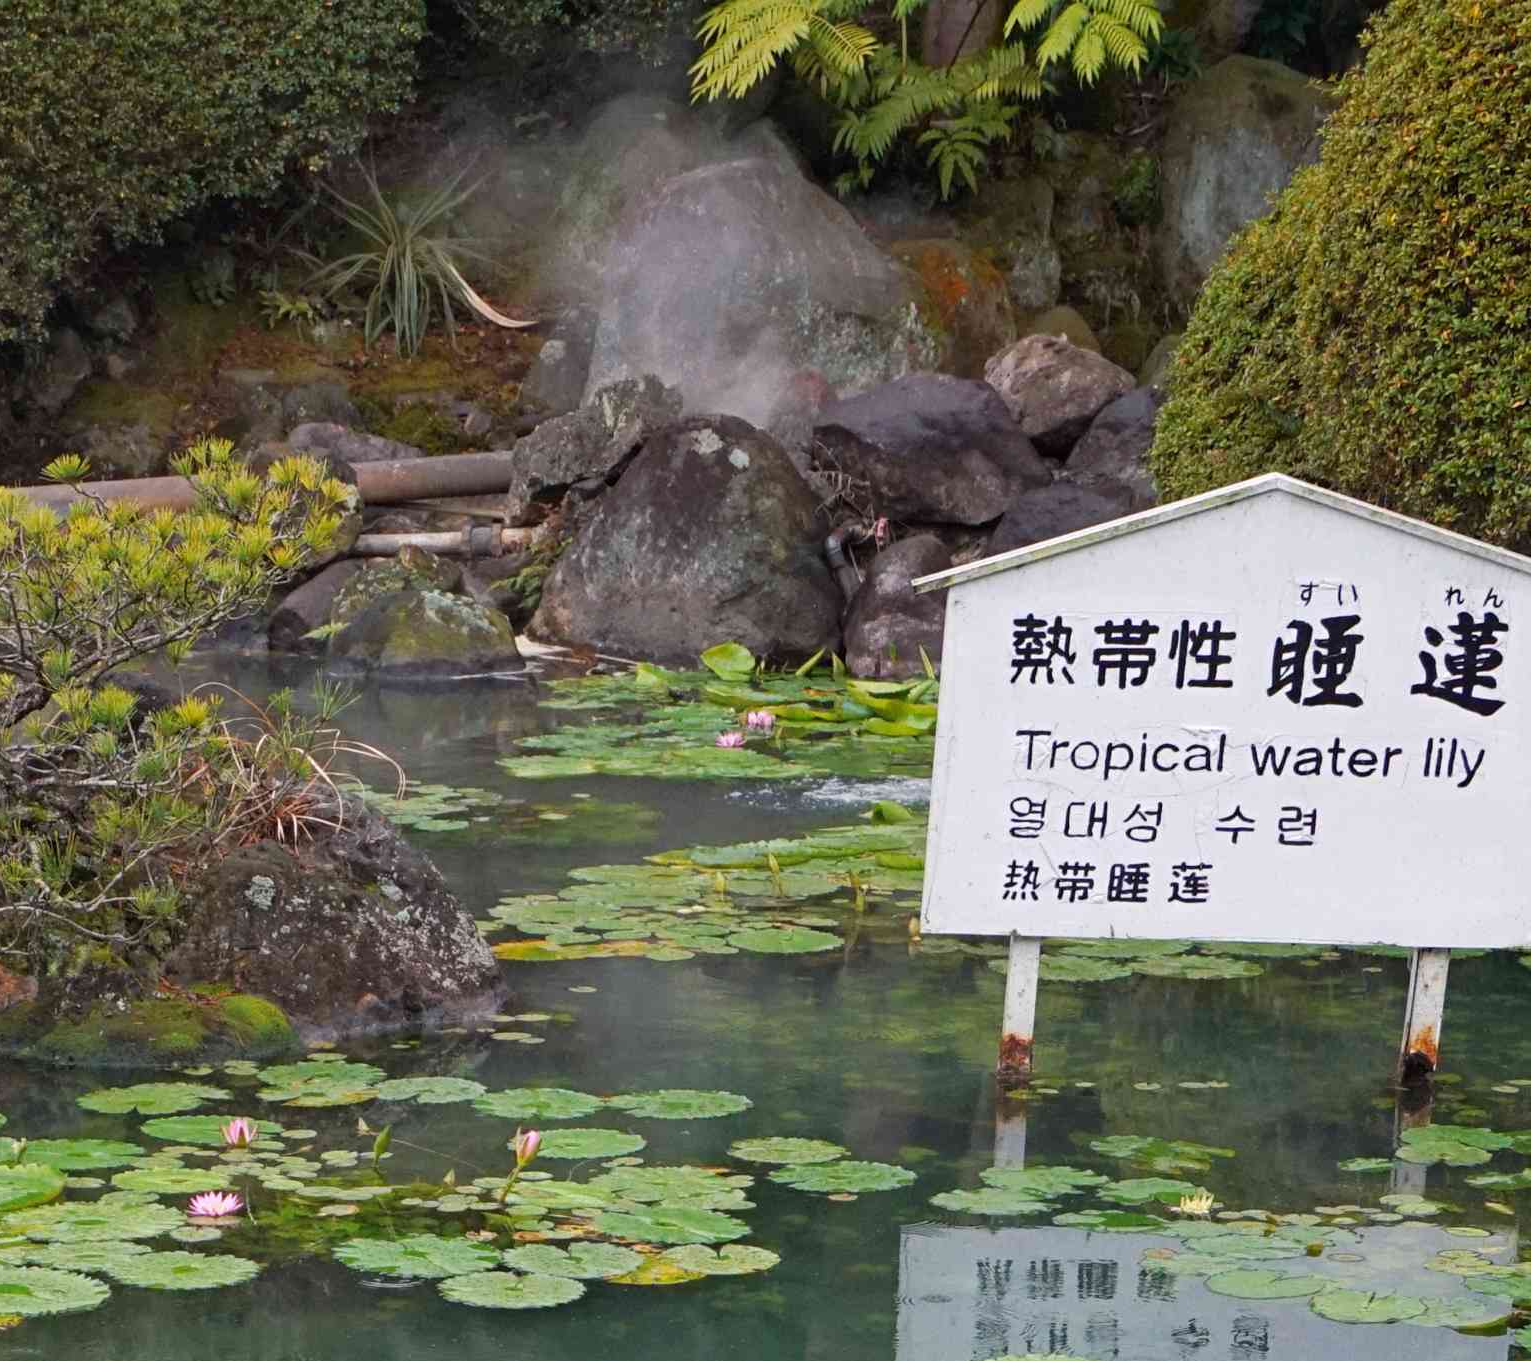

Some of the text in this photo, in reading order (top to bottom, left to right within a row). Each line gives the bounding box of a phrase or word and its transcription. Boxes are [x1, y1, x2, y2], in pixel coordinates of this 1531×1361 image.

[1300, 583, 1504, 609] すい れん
[1015, 729, 1486, 788] Tropical water lily
[1009, 796, 1317, 846] 열대성 수련
